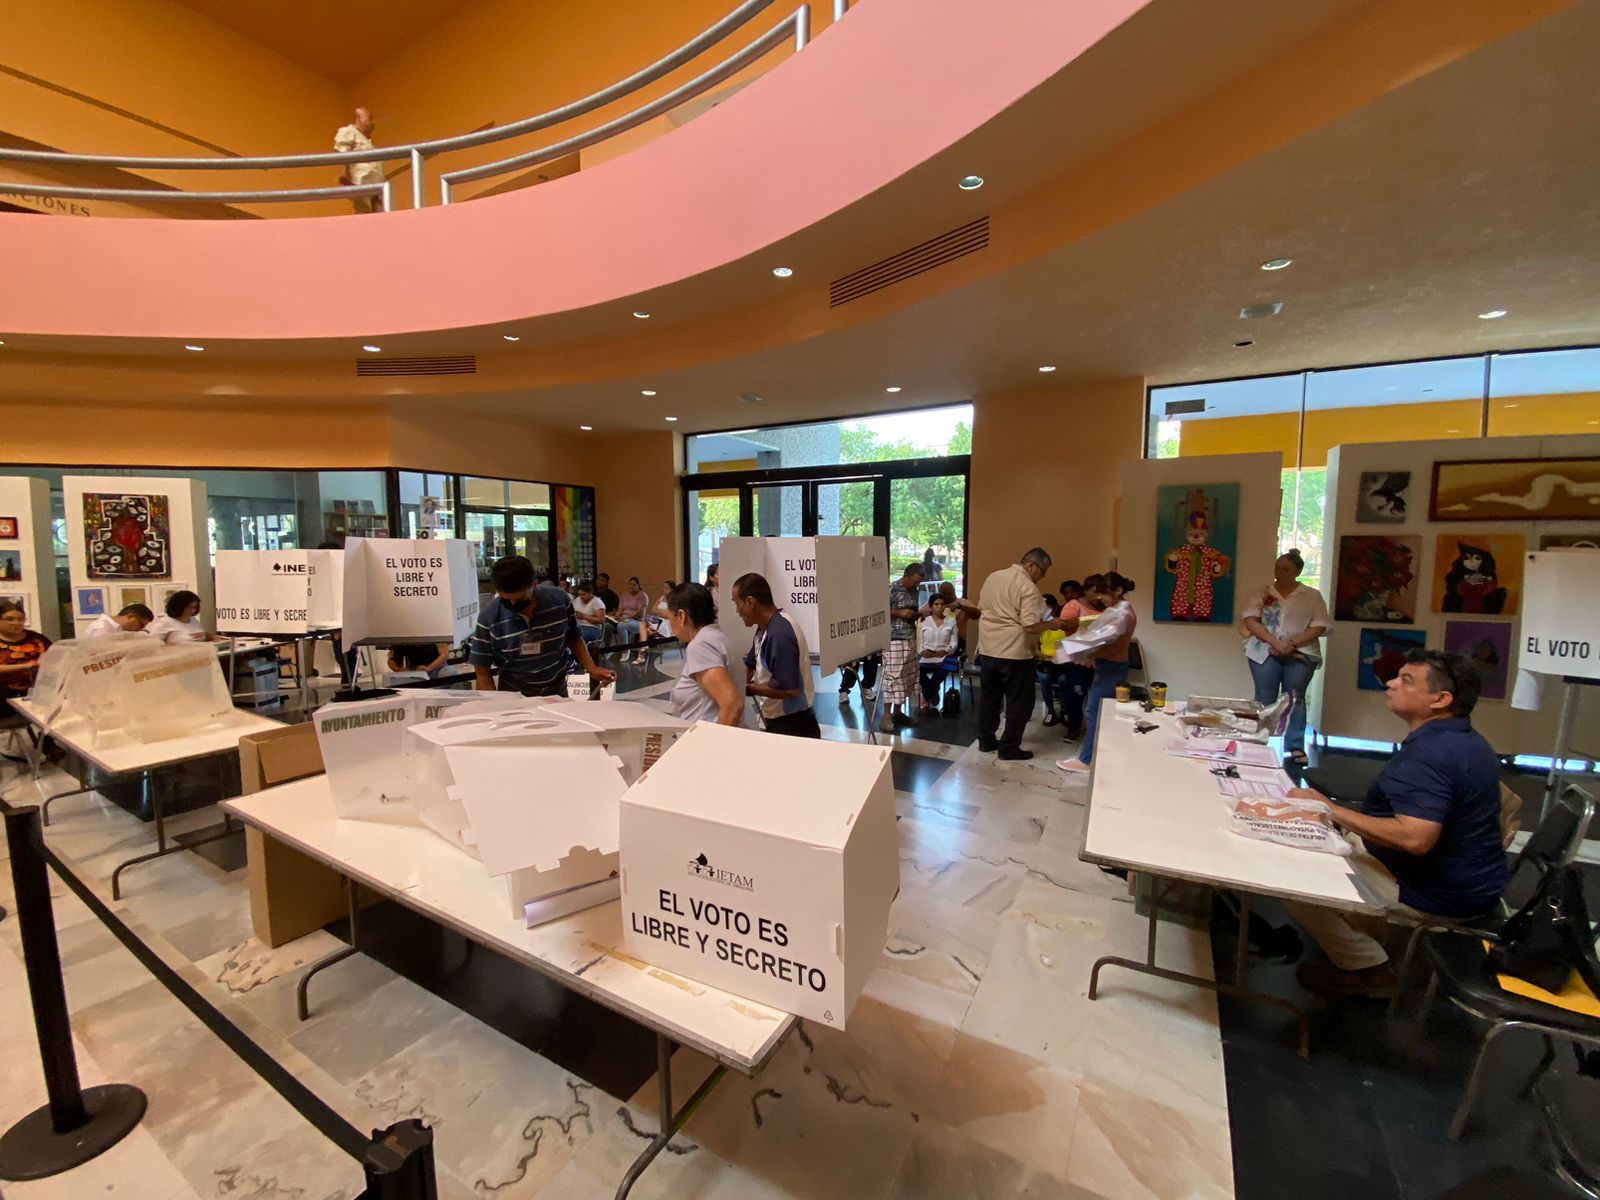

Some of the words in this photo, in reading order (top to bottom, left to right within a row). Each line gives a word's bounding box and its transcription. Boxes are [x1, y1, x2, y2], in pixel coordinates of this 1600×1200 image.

[6, 192, 90, 217] CIONES
[283, 564, 306, 573] INE
[386, 558, 397, 568] EL
[401, 558, 427, 568] VOTO
[430, 558, 443, 568] ES
[785, 559, 796, 571] EL
[396, 572, 424, 583] LIBRE
[427, 572, 434, 582] Y
[794, 576, 817, 588] LIBR
[394, 586, 438, 597] SECRETO
[240, 609, 250, 620] ES
[254, 609, 271, 621] LIBRE
[274, 610, 279, 621] Y
[830, 623, 837, 639] EL
[838, 620, 849, 637] VOTO
[850, 618, 856, 634] ES
[1527, 637, 1541, 654] EL
[1549, 640, 1590, 659] VOTO
[321, 707, 405, 734] AYUNTAMIENTO
[716, 869, 754, 888] IETAM
[659, 889, 684, 916] EL
[689, 898, 751, 935] VOTO
[758, 917, 789, 947] ES
[632, 912, 690, 949] LIBRE
[696, 931, 709, 954] Y
[716, 938, 826, 993] SECRETO
